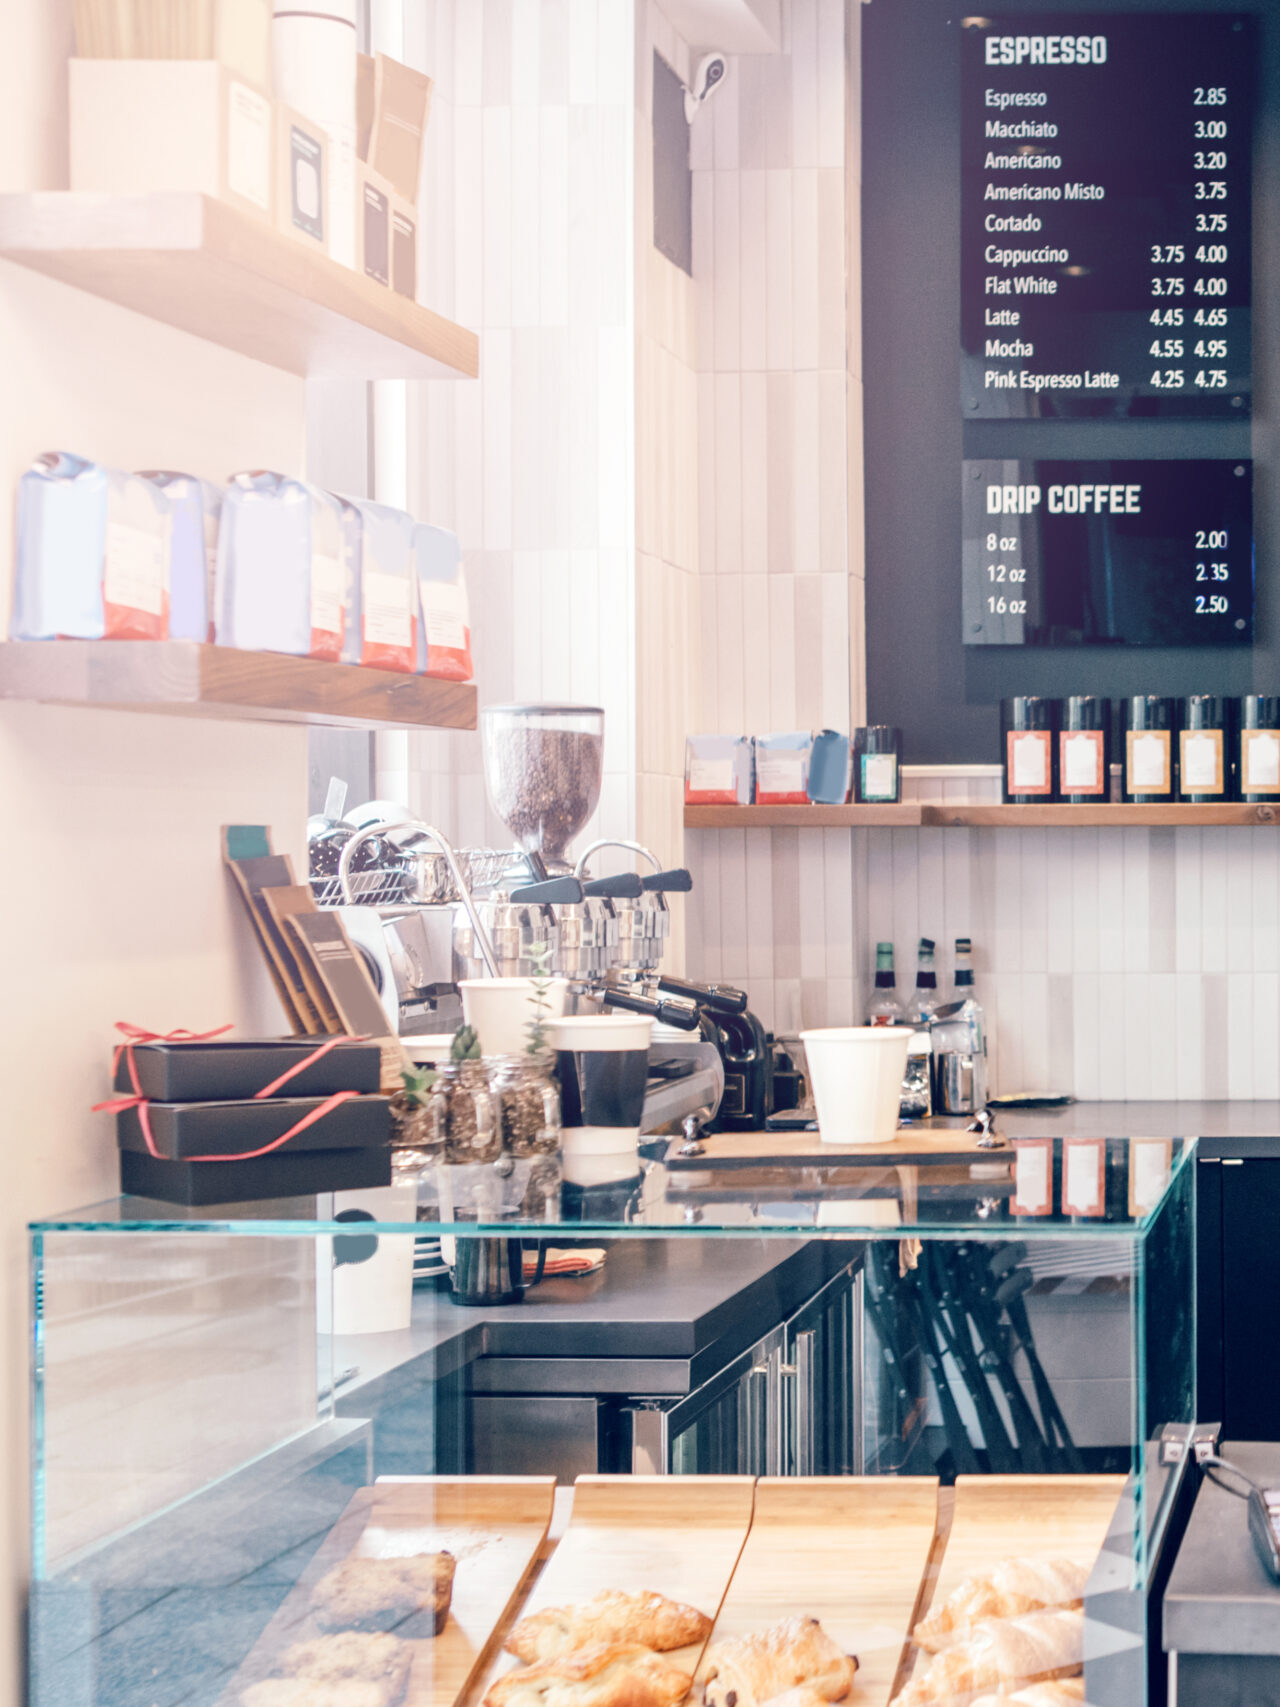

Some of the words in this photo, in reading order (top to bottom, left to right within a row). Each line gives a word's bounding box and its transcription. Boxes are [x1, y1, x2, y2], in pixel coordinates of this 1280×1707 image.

[985, 36, 1107, 64] ESPRESSO
[985, 89, 1047, 110] Espresso
[1194, 88, 1226, 105] 2.85
[985, 121, 1058, 138] Macchiato
[1194, 121, 1227, 138] 3.00
[984, 152, 1062, 169] Americano
[1194, 152, 1227, 169] 3.20
[984, 183, 1062, 200] Americano
[1064, 183, 1104, 200] Misto
[1194, 182, 1227, 200] 3.75
[985, 214, 1042, 232] Cortado
[1196, 214, 1227, 232] 3.75
[985, 245, 1068, 268] Cappuccino
[1151, 246, 1184, 263] 3.75
[1195, 246, 1228, 263] 4.00
[985, 276, 1011, 294] Flat
[1014, 276, 1058, 294] White
[1151, 278, 1184, 296] 3.75
[1194, 278, 1228, 296] 4.00
[985, 308, 1020, 326] Latte
[1150, 309, 1184, 326] 4.45
[1194, 309, 1227, 326] 4.65
[985, 339, 1034, 357] Mocha
[1150, 340, 1184, 358] 4.55
[1194, 340, 1227, 358] 4.95
[985, 370, 1017, 388] Pink
[1020, 371, 1082, 392] Espresso
[1085, 371, 1120, 388] Latte
[1150, 370, 1184, 388] 4.25
[1194, 370, 1227, 388] 4.75
[987, 486, 1040, 514] DRIP
[1048, 485, 1142, 514] COFFEE
[987, 533, 997, 551] 8
[1000, 537, 1017, 551] oz
[1195, 531, 1228, 548] 2.00
[988, 565, 1006, 582] 12
[1009, 568, 1026, 583] oz
[1196, 564, 1228, 581] 2.35
[988, 596, 1006, 614] 16
[1010, 600, 1026, 614] oz
[1195, 596, 1228, 614] 2.50
